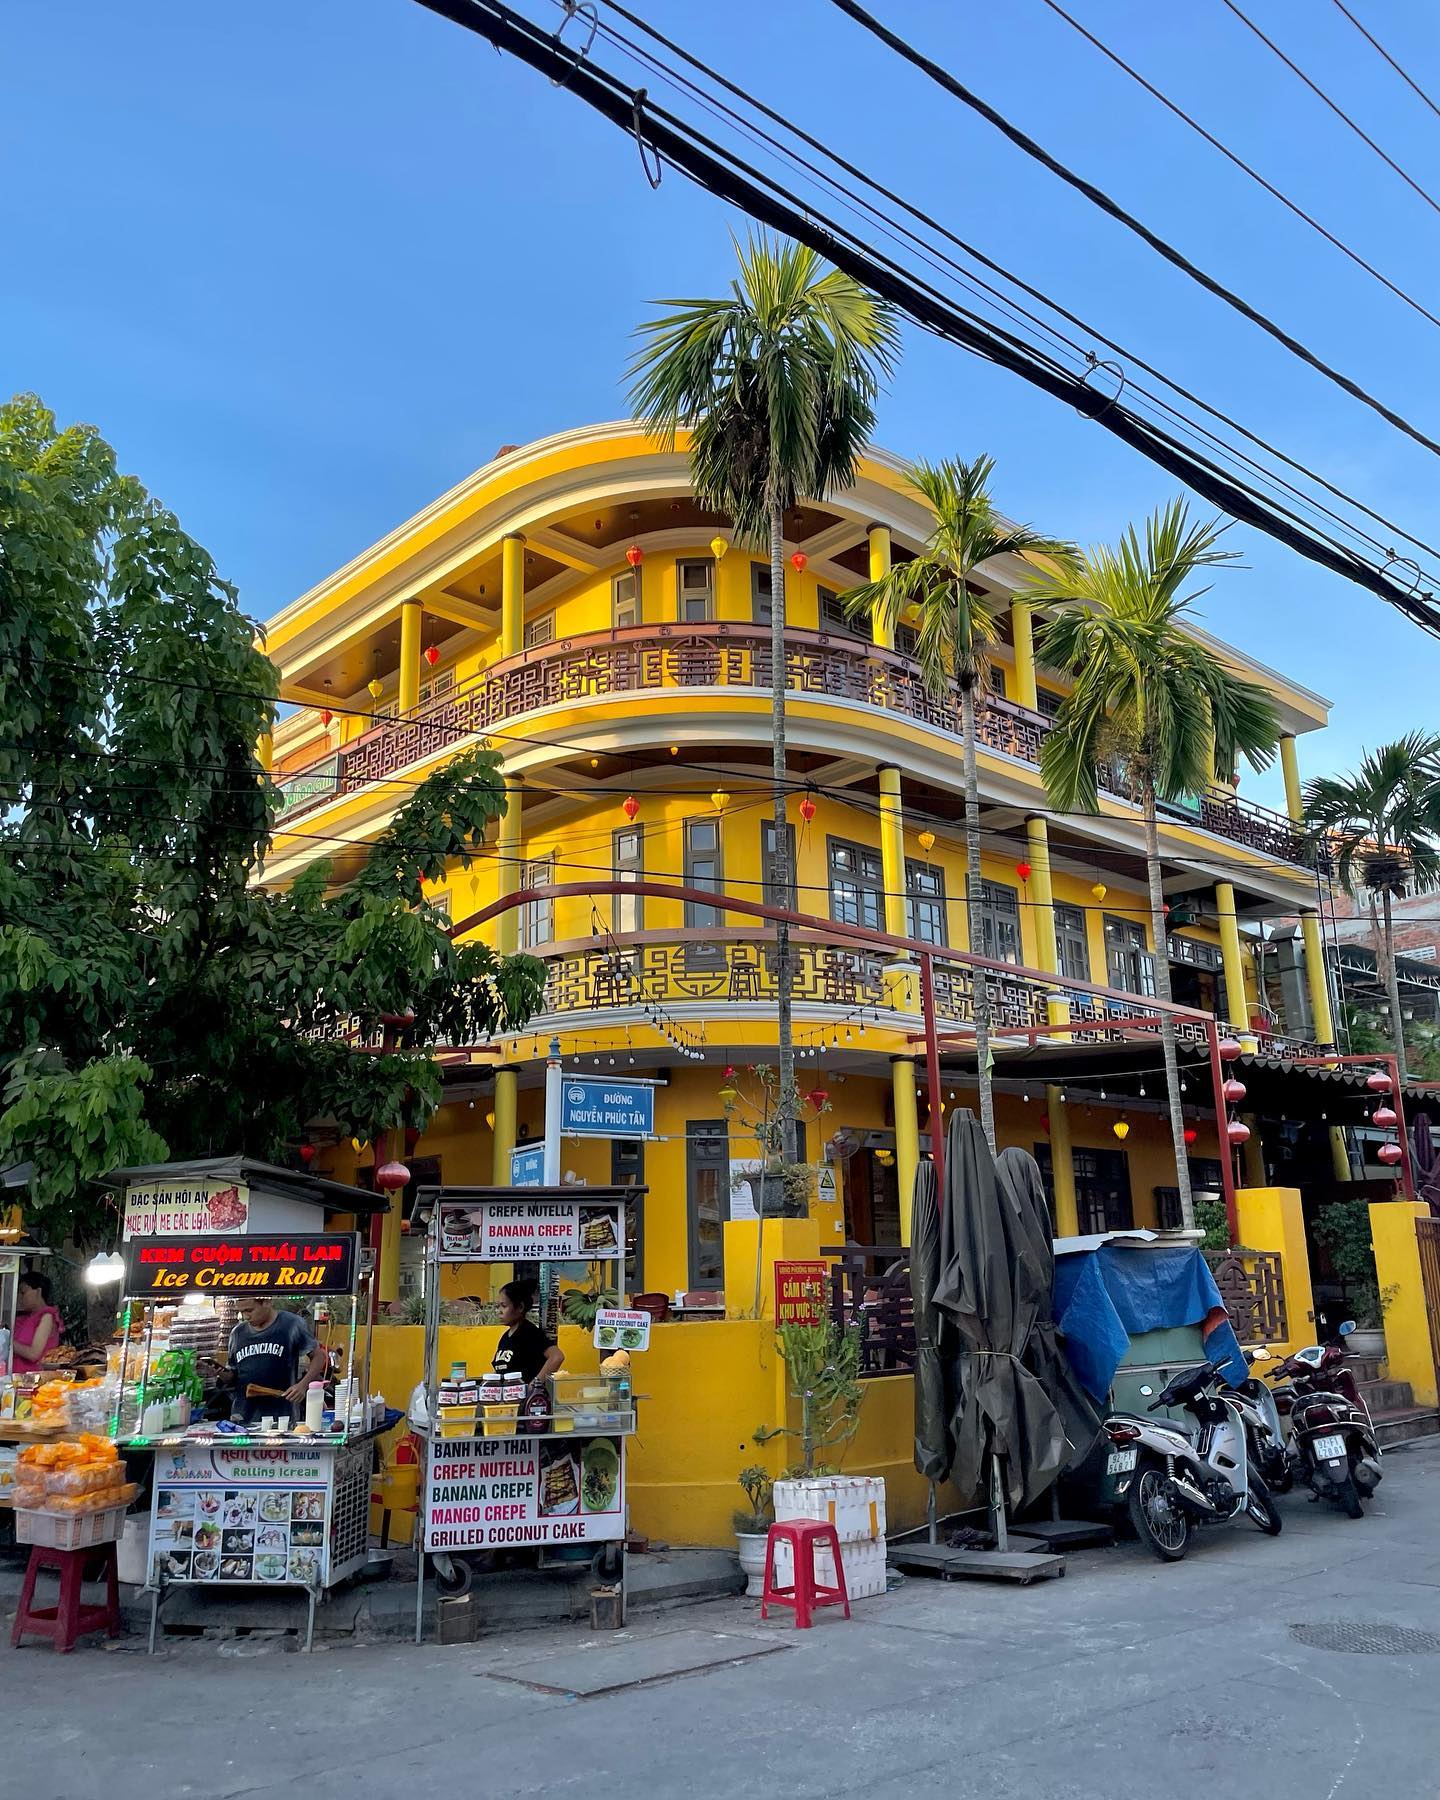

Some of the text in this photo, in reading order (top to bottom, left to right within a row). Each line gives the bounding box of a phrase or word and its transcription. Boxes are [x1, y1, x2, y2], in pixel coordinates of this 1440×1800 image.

[603, 1092, 633, 1105] ĐƯỜNG
[569, 1105, 603, 1124] NGUYỄN
[604, 1109, 627, 1124] PHÚC
[131, 1189, 209, 1208] ĐẶC SẢN HỘI AN
[173, 1210, 189, 1230] CÁC
[488, 1205, 574, 1218] CREPE NUTELLA
[488, 1224, 573, 1237] BANANA CREPE
[140, 1247, 185, 1263] KEM
[250, 1242, 298, 1262] THÁI
[303, 1245, 343, 1261] LAN
[489, 1242, 572, 1257] BÁNH KÉP THÁI
[151, 1266, 326, 1287] Ice Cream Roll
[783, 1276, 800, 1298] CẤM
[812, 1281, 821, 1297] XE
[779, 1303, 795, 1319] KHU
[236, 1342, 285, 1363] BALENCIAGA
[307, 1451, 320, 1460] LAN
[233, 1467, 275, 1478] Rolling
[433, 1460, 535, 1480] CREPE NUTELLA
[432, 1482, 533, 1503] BANANA CREPE
[431, 1504, 527, 1525] MANGO CREPE
[431, 1522, 586, 1547] GRILLED COCONUT CAKE
